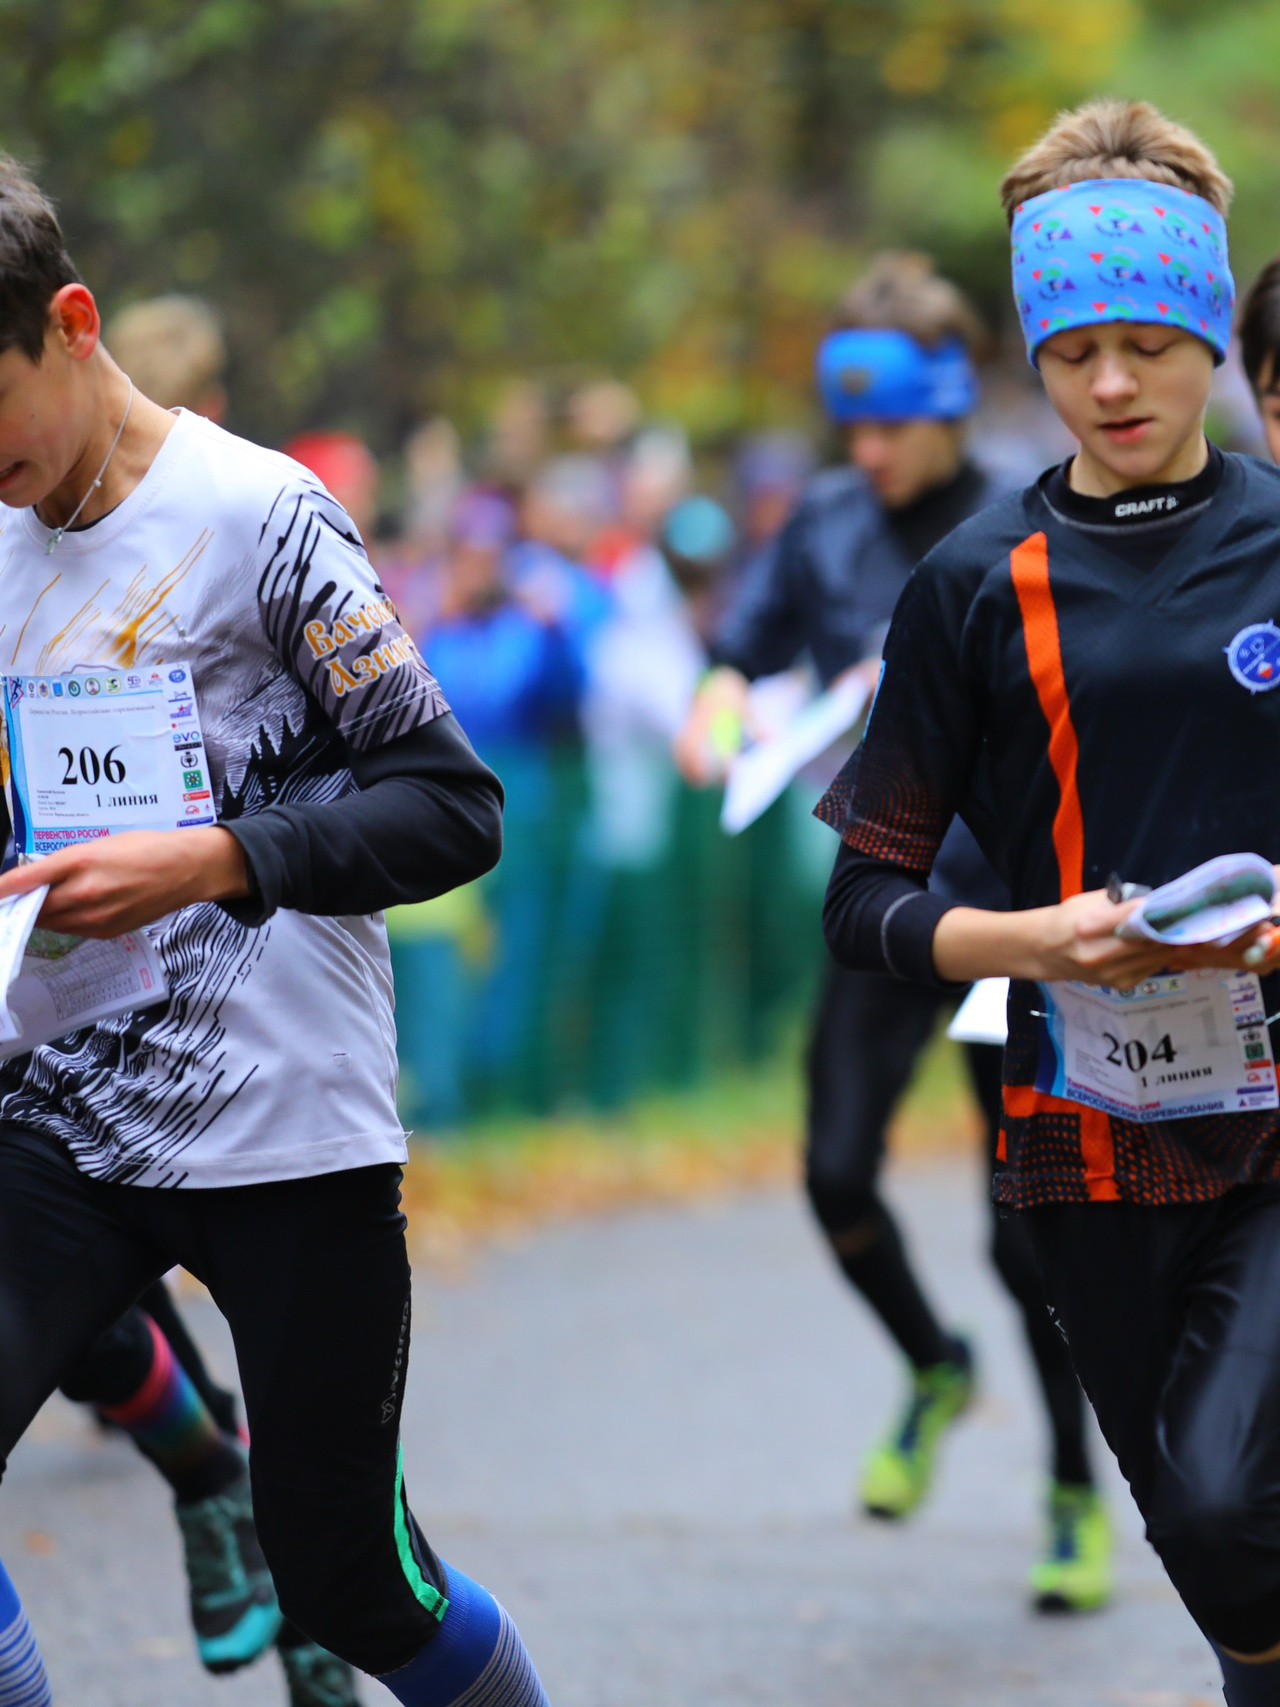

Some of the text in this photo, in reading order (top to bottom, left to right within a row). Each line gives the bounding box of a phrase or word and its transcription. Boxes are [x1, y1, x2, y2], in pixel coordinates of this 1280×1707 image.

[1115, 497, 1165, 517] CRAFT
[173, 730, 200, 743] evo
[57, 744, 126, 785] 206
[96, 794, 158, 807] 1 линия
[34, 828, 110, 840] ПЕРВЕНСТВО РОССИИ
[1103, 1033, 1177, 1072] 204
